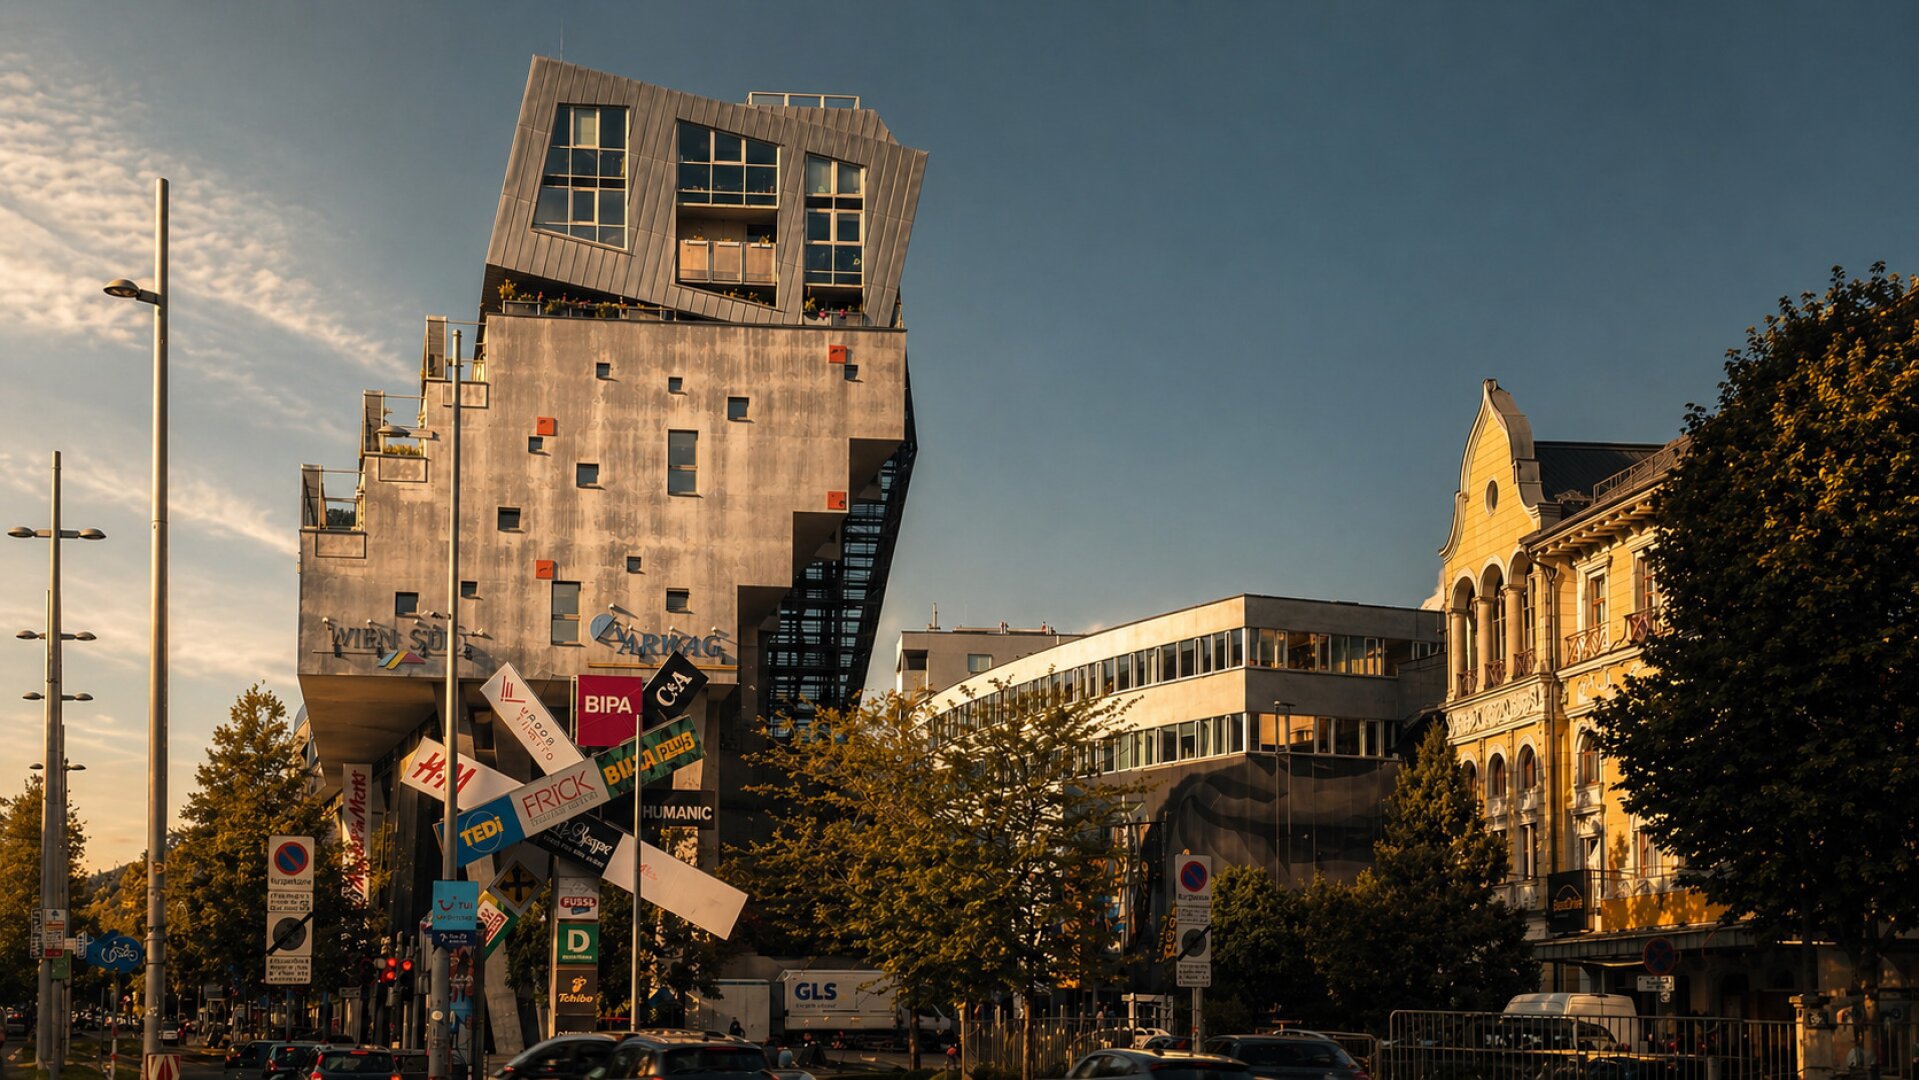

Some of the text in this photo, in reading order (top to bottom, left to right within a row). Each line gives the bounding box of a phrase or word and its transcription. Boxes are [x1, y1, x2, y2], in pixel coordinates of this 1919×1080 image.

[331, 627, 396, 649] WIEN
[615, 629, 724, 658] ARWAG
[656, 671, 693, 707] C&A
[584, 694, 632, 714] BIPA
[522, 770, 596, 818] FRICK
[643, 804, 713, 821] HUMANIC
[567, 929, 591, 953] D
[558, 993, 594, 1003] Tchibo
[795, 982, 837, 1001] GLS
